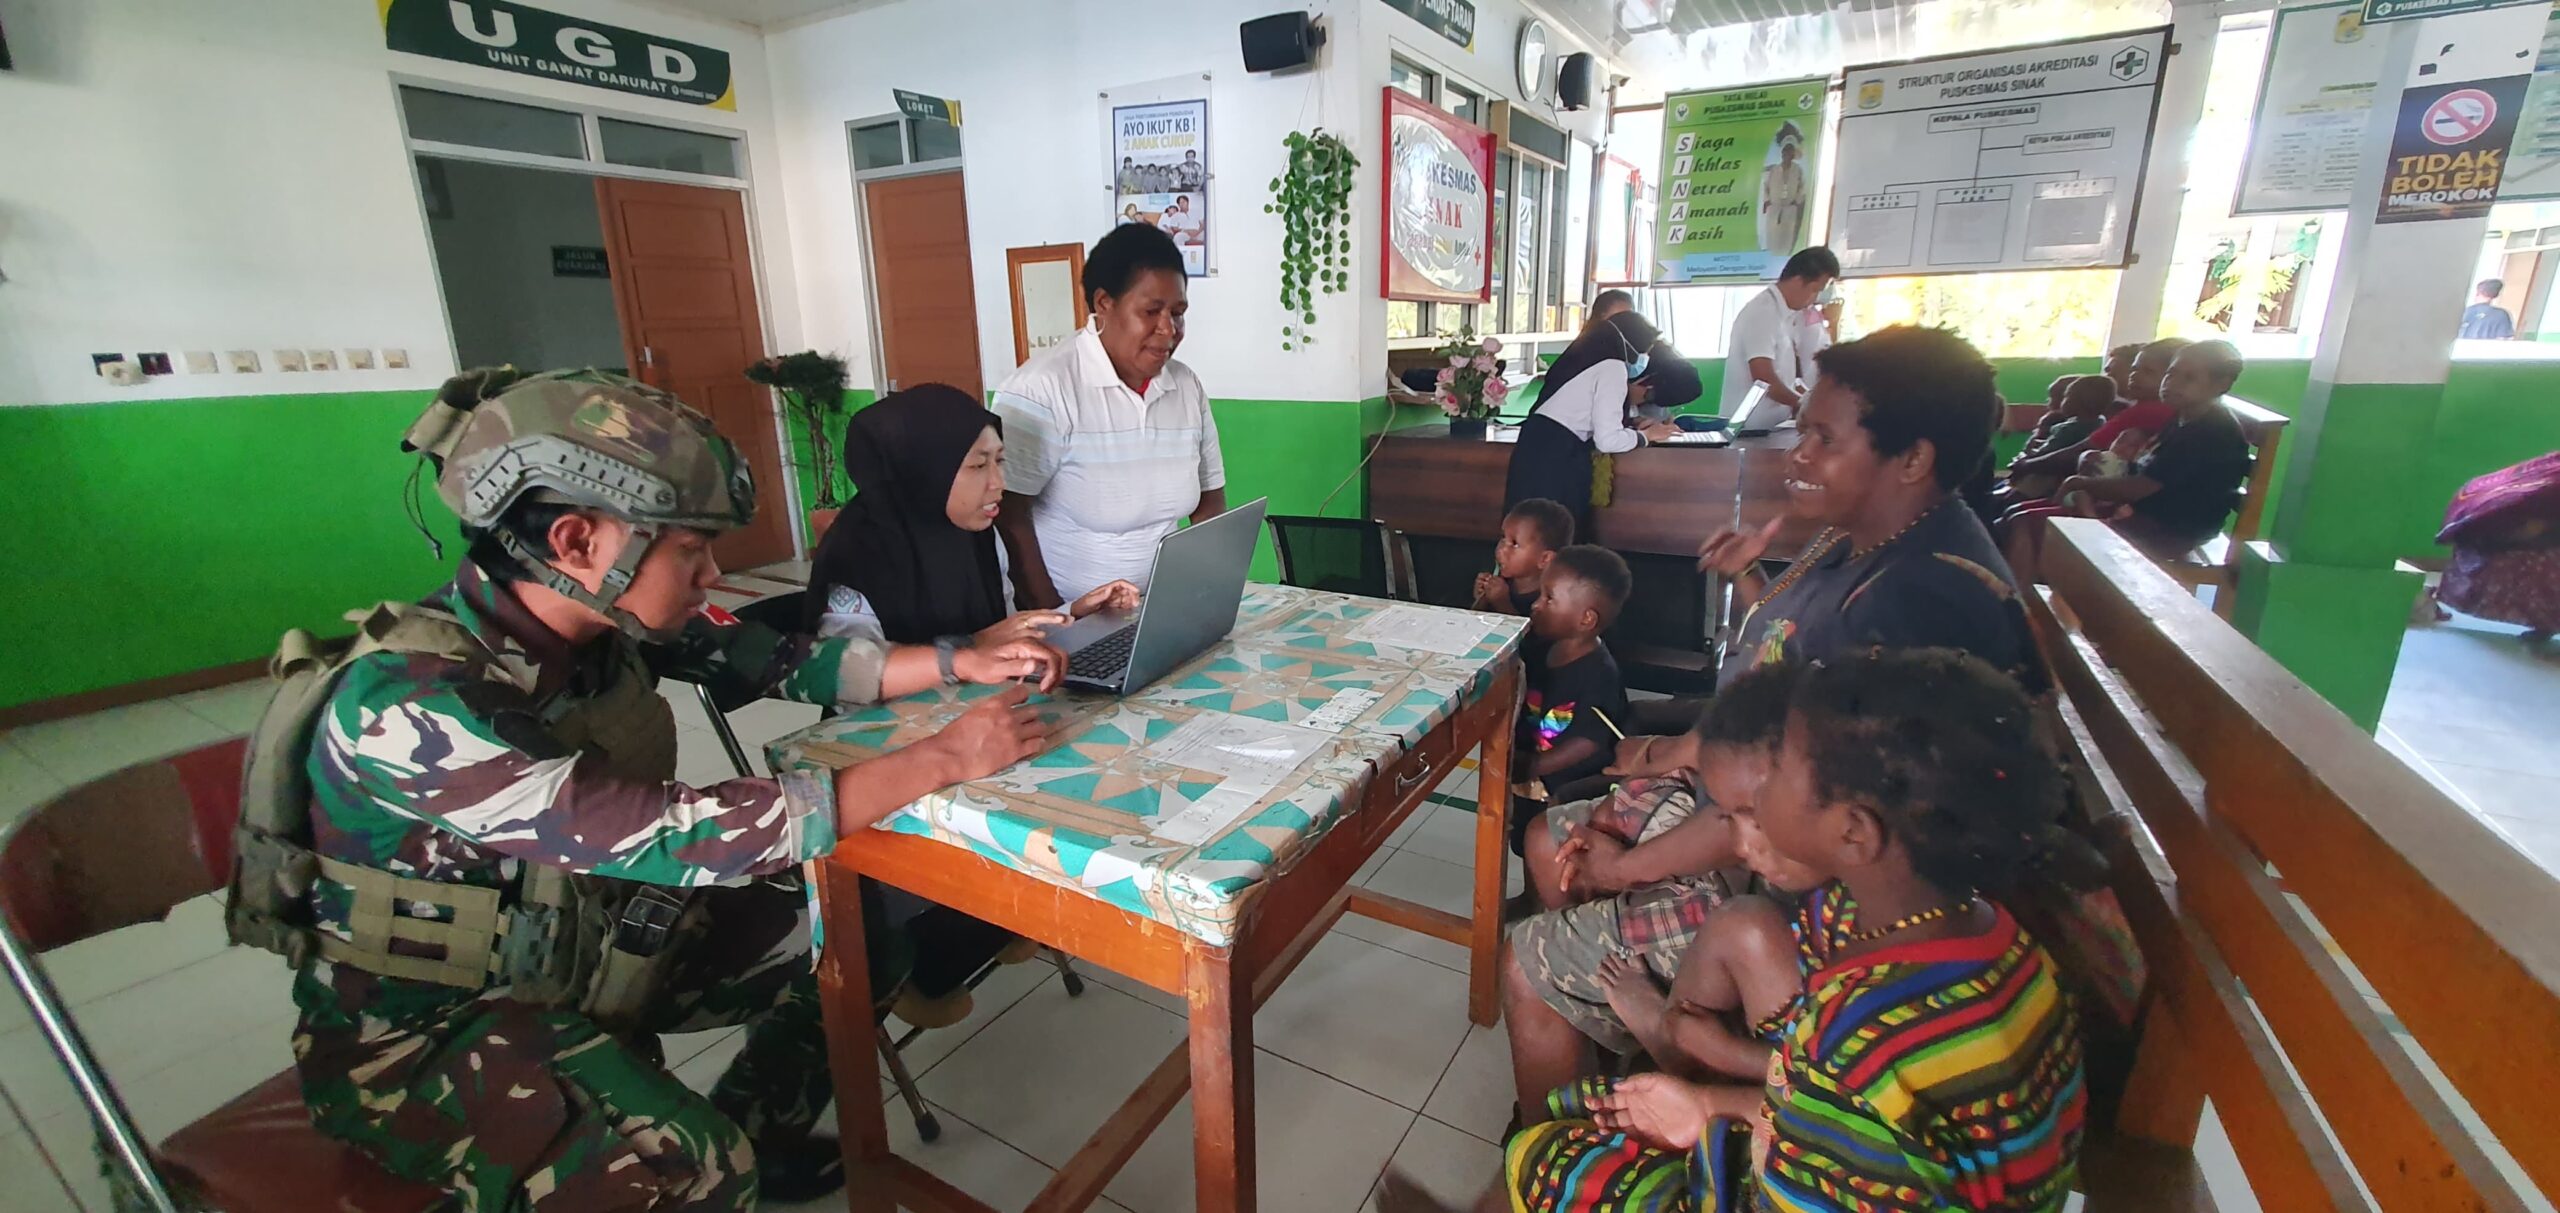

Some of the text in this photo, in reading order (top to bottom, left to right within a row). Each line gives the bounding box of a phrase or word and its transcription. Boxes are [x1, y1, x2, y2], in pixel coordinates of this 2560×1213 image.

[487, 49, 667, 93] UNIT GAWAT DARURAT
[1898, 54, 2099, 90] STRUKTUR ORGANISASI AKREDITASI
[1939, 76, 2047, 99] PUSKESMAS SINAK
[906, 101, 934, 115] LOKET
[1933, 112, 1971, 124] KEPALA
[1974, 106, 2036, 120] PUSKESMAS
[1123, 120, 1145, 137] AYO
[1147, 119, 1173, 136] IKUT
[1175, 117, 1190, 133] KB
[1123, 133, 1196, 151] 2 ANAK CUKUP
[1677, 135, 1735, 152] Siaga
[1677, 156, 1742, 175] Ikhlas
[2397, 148, 2502, 175] TIDAK
[1673, 179, 1735, 198] Netral
[2390, 168, 2498, 194] BOLEH
[2388, 187, 2496, 207] MEROKOK
[1671, 201, 1750, 220] Amanah
[1669, 225, 1724, 243] Kasih
